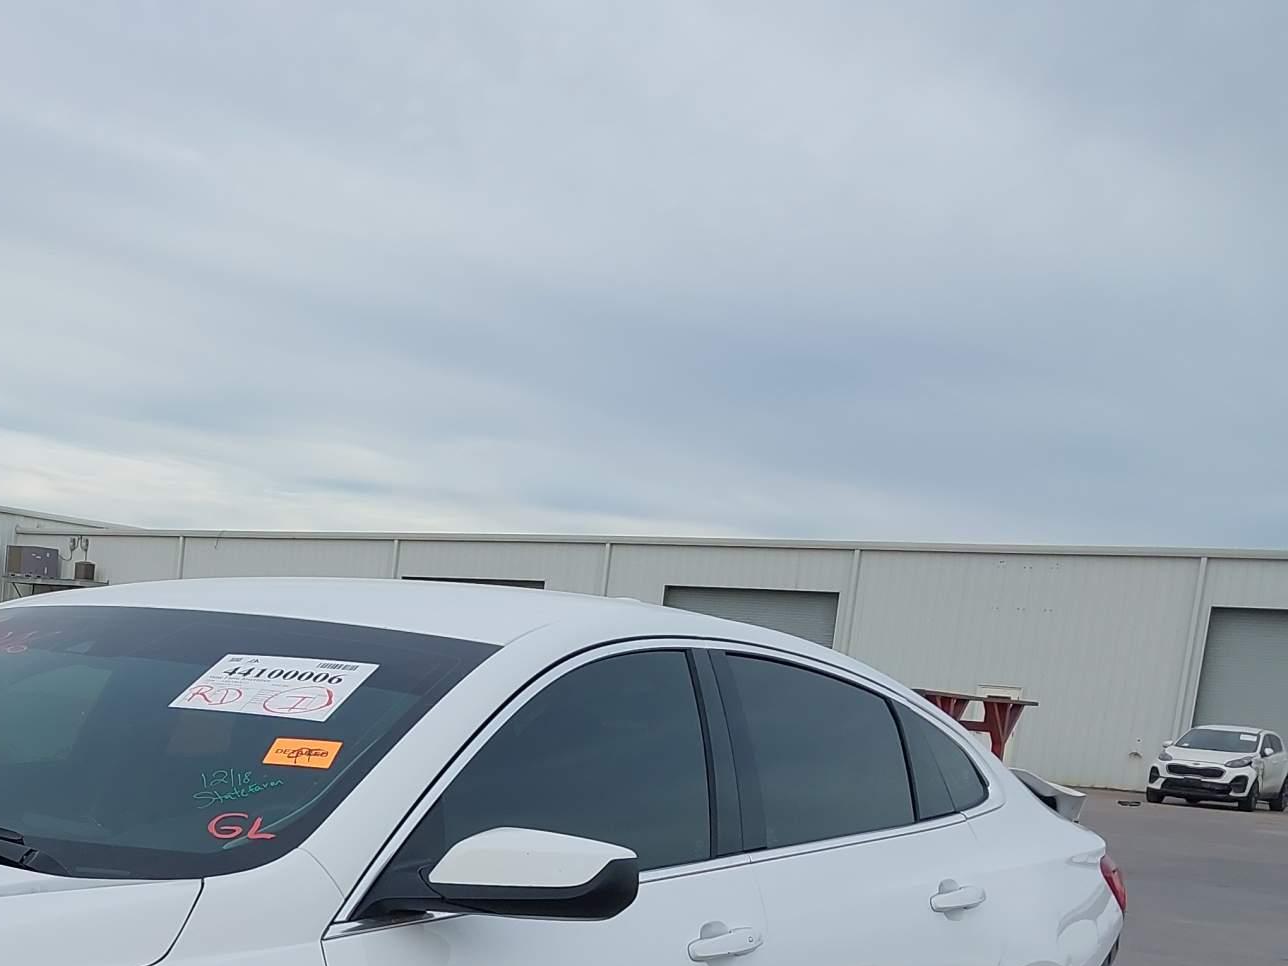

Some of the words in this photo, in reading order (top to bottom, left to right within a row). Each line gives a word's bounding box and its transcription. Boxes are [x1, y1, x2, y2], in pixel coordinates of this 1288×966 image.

[222, 666, 344, 685] 44100006
[187, 684, 243, 706] RD
[201, 768, 252, 788] 12/18
[207, 812, 277, 840] GL
